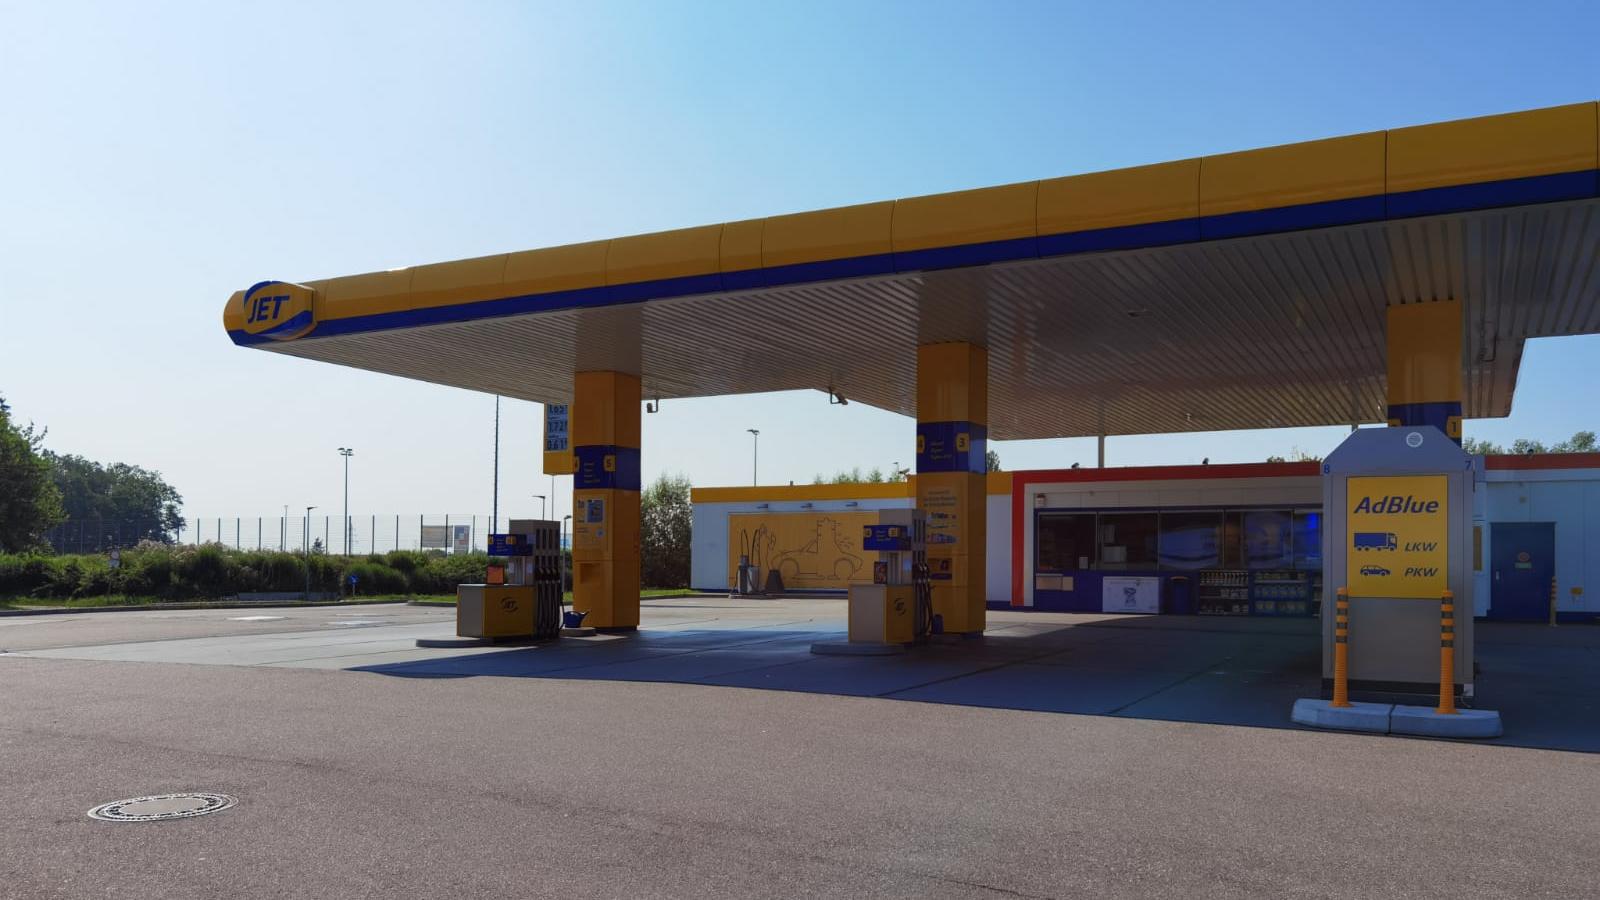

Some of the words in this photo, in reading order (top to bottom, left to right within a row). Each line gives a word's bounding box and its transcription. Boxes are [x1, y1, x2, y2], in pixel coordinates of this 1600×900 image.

[248, 296, 290, 323] JET
[1323, 464, 1330, 474] 8
[1464, 460, 1472, 471] 7
[1353, 495, 1439, 515] AdBlue
[1405, 542, 1438, 552] LKW
[1404, 567, 1438, 577] PKW
